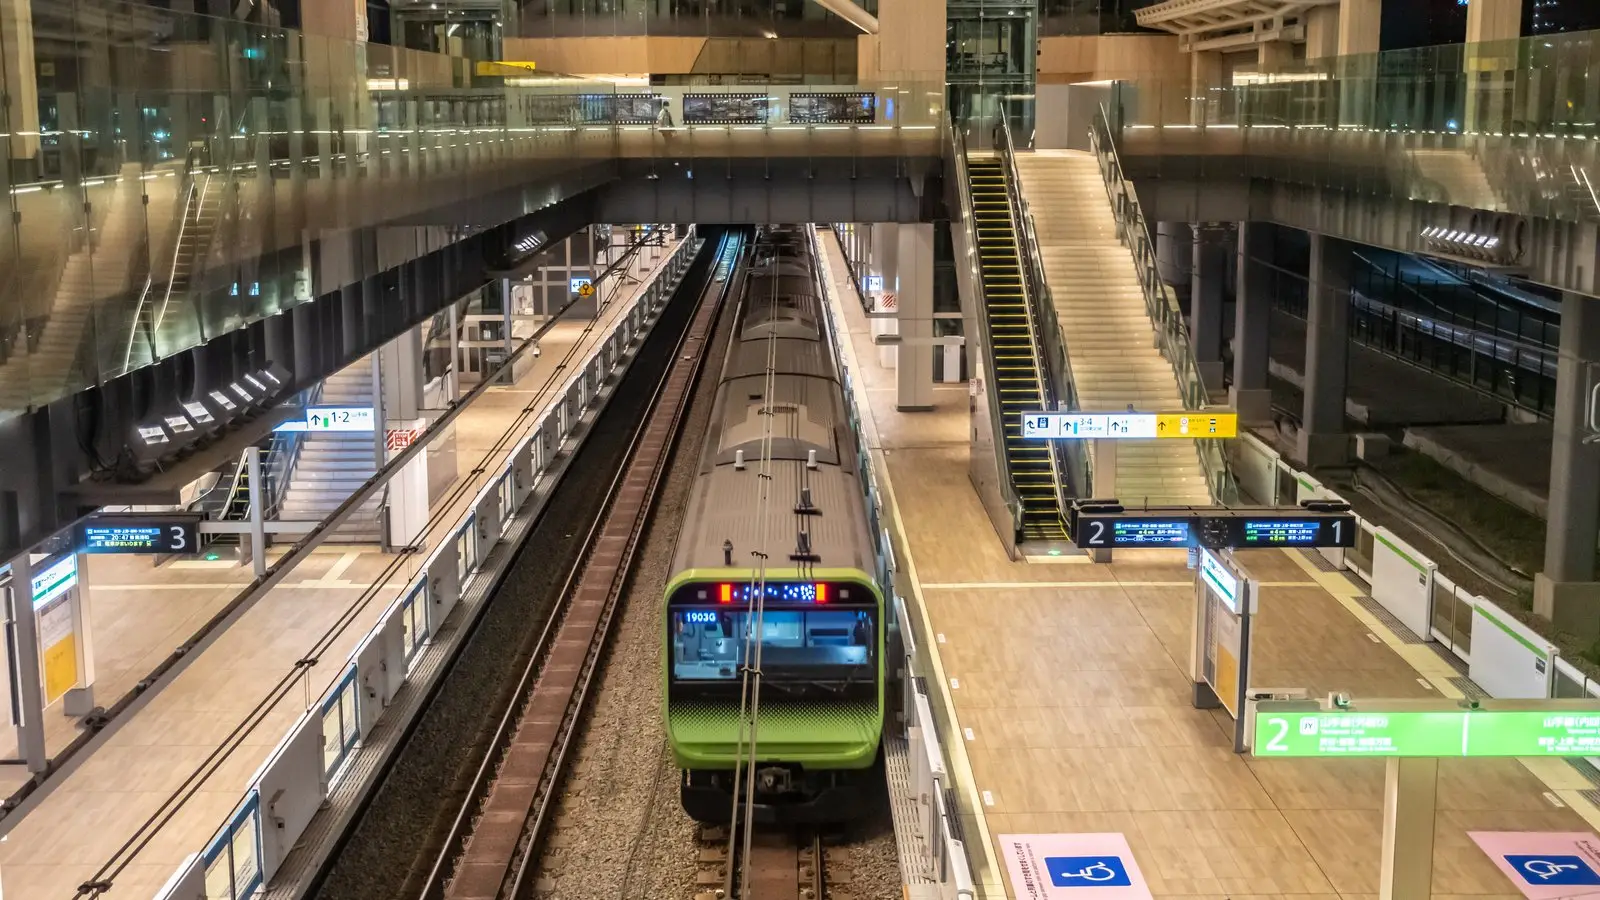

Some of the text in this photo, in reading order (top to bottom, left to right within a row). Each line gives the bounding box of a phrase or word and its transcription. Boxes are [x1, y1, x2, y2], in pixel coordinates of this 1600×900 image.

[170, 526, 186, 549] 3
[1089, 521, 1104, 544] 2
[1332, 521, 1341, 543] 1
[686, 612, 716, 622] 1903G
[1265, 718, 1289, 751] 2
[1303, 721, 1313, 731] JY
